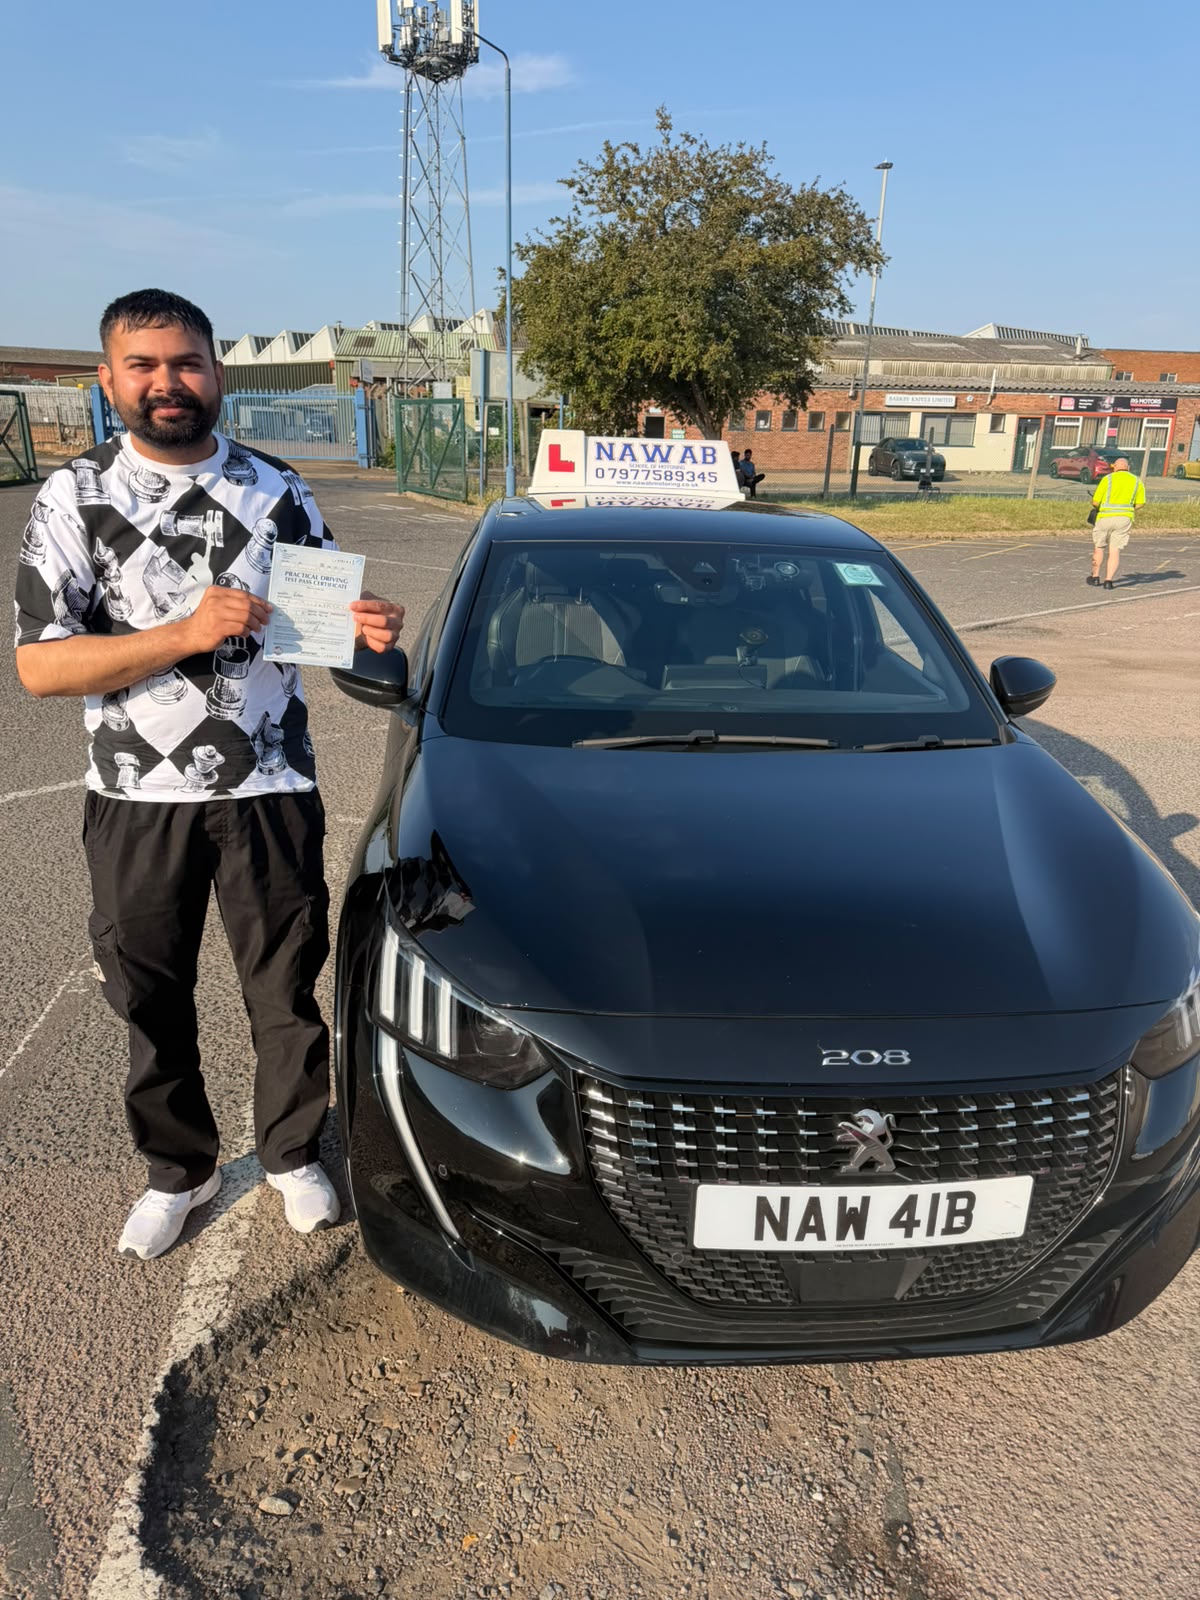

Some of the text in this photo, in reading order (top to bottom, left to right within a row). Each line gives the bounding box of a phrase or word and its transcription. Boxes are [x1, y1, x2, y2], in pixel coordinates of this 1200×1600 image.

[548, 443, 575, 472] L
[595, 441, 717, 465] NAWAB
[595, 467, 718, 484] 07977589345
[284, 570, 349, 584] PRACTICAL DRIVING
[313, 580, 348, 590] CERTIFICATE
[821, 1049, 911, 1066] 208
[754, 1190, 977, 1241] NAW 41B
